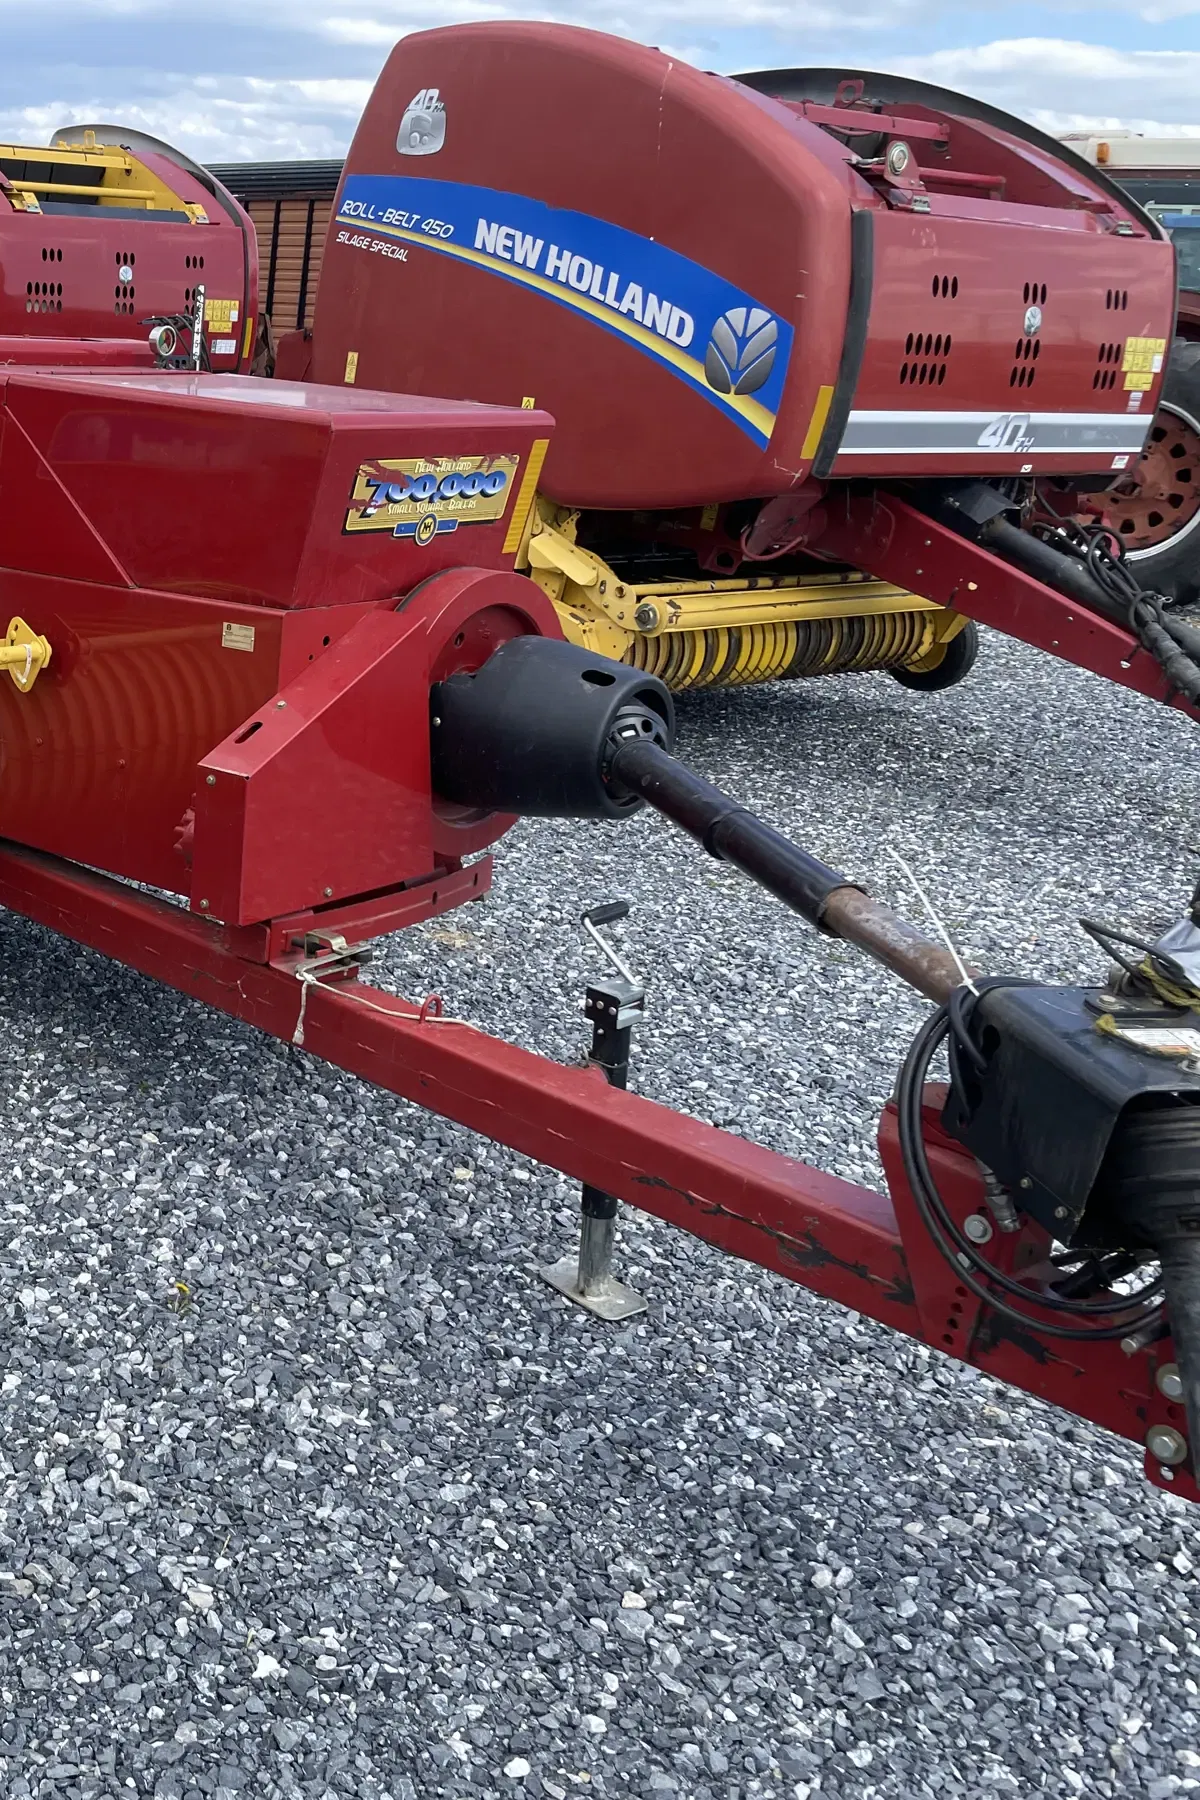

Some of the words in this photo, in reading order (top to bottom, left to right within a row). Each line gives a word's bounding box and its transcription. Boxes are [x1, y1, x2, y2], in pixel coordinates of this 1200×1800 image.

[421, 218, 455, 239] 450
[336, 231, 372, 250] SILAGE
[369, 240, 409, 262] SPECIAL
[474, 218, 545, 270] NEW
[545, 244, 695, 348] HOLLAND
[387, 503, 413, 516] SMALL
